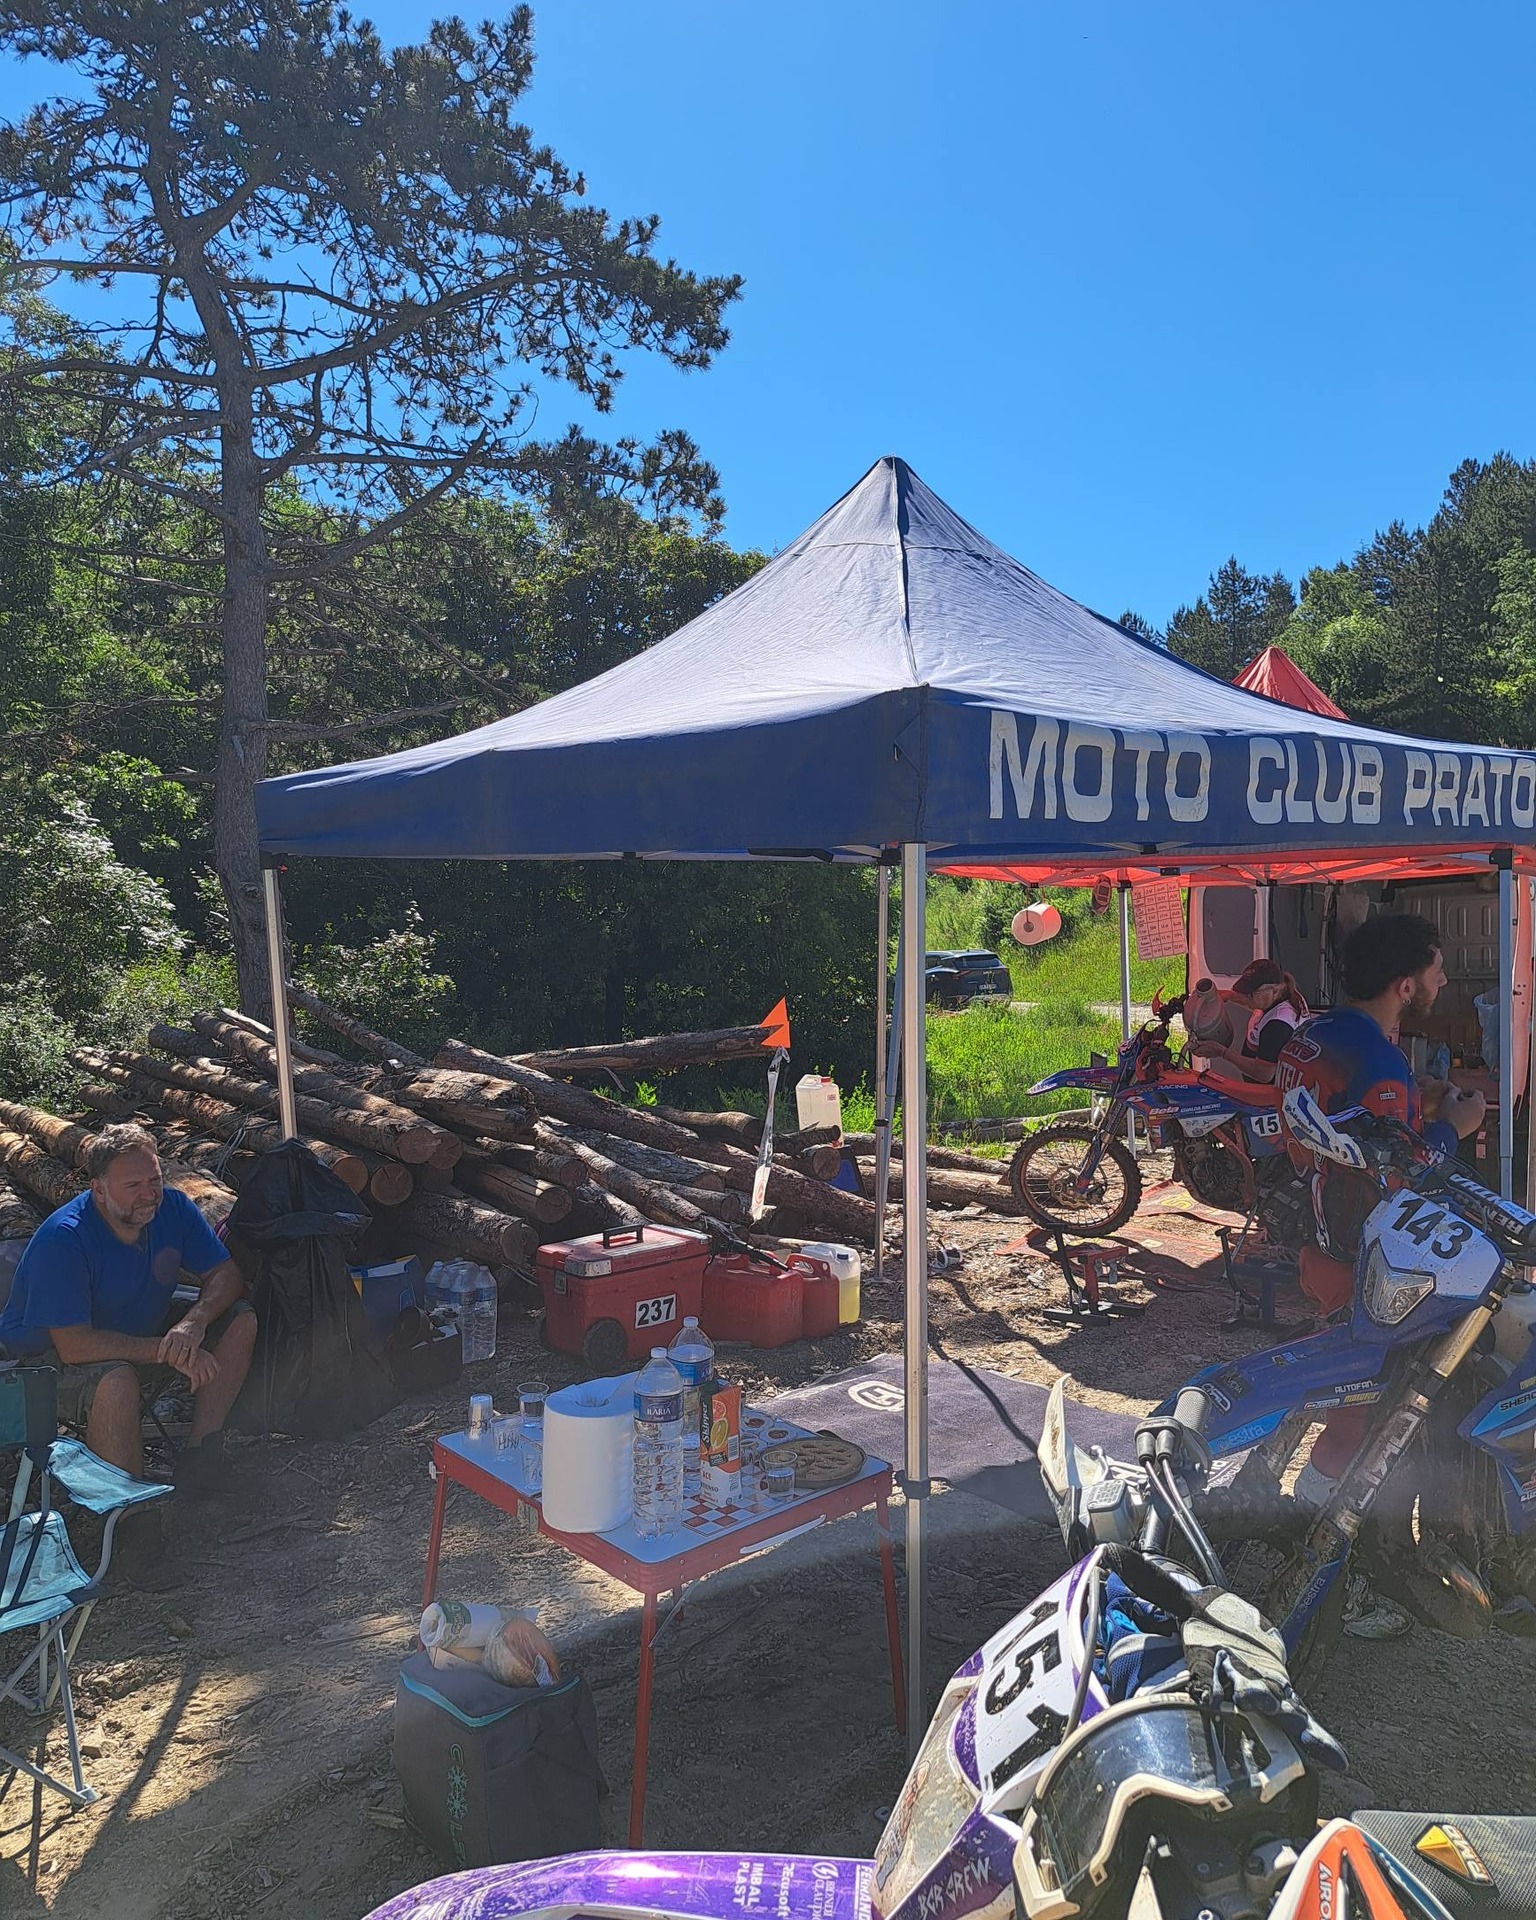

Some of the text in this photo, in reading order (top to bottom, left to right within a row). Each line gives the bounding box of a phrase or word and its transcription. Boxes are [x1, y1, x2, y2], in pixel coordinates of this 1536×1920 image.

[989, 710, 1536, 828] MOTO CLUB PRATO
[1255, 1116, 1279, 1134] 15
[1391, 1198, 1473, 1260] 143
[637, 1297, 674, 1326] 237
[646, 1407, 672, 1416] ILARIA
[701, 1402, 709, 1443] Skipper
[985, 1600, 1070, 1791] 151
[733, 1861, 750, 1906] PLAST
[747, 1862, 764, 1907] IMBAL
[945, 1856, 990, 1904] CREW
[1318, 1861, 1332, 1920] AIRO
